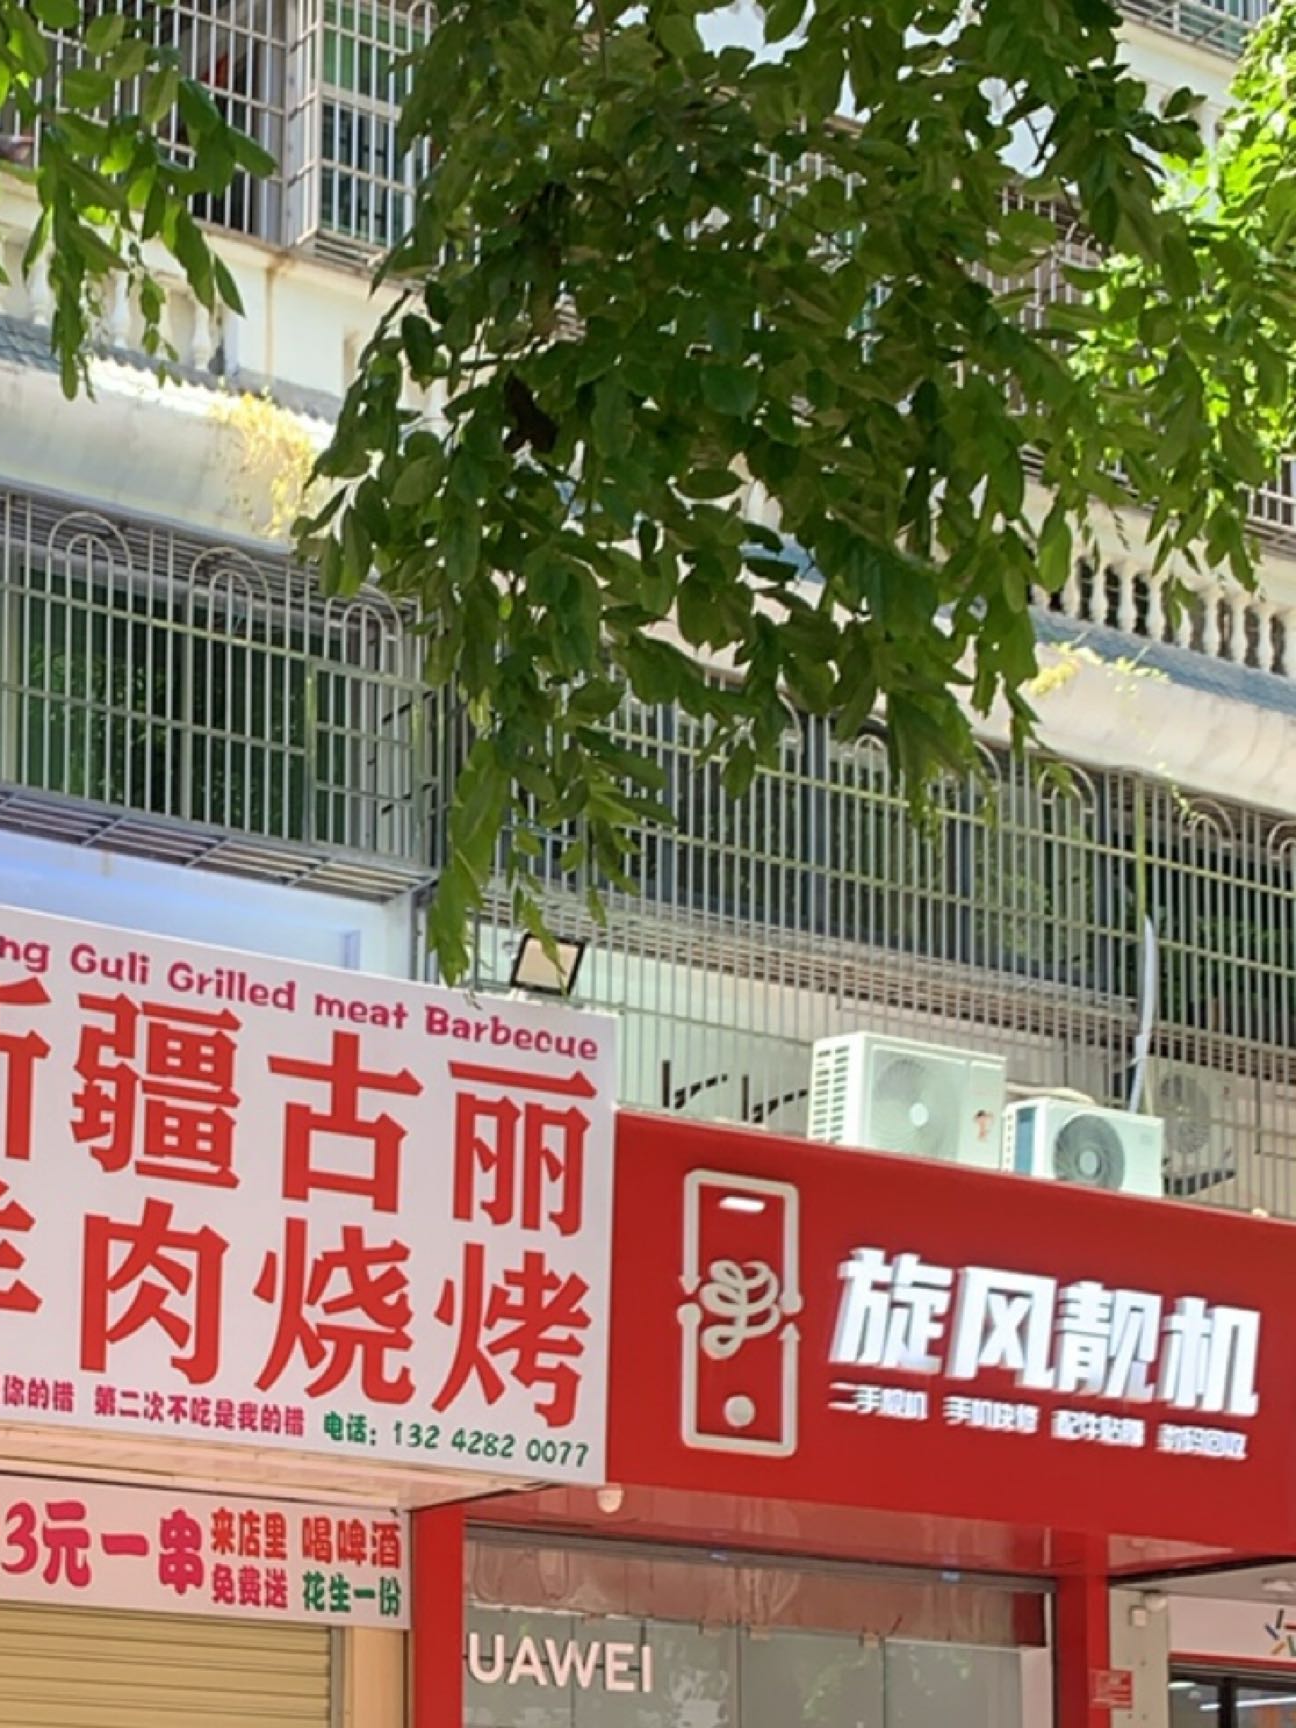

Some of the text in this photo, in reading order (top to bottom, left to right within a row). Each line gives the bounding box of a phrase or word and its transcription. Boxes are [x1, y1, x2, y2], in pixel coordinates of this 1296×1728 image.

[70, 943, 150, 985] Guli
[167, 961, 296, 1012] Grilled
[314, 993, 408, 1030] meat
[424, 1005, 599, 1060] Barbecue
[828, 1247, 1260, 1417] 旋风靓机
[93, 1384, 305, 1436] 第二次不吃是我的错
[394, 1420, 440, 1449] 132
[451, 1428, 515, 1458] 4282
[526, 1439, 589, 1468] 0077
[2, 1501, 203, 1595] 3元一串
[211, 1506, 401, 1569] 来店里 喝啤酒
[212, 1562, 401, 1616] 免费送 花生一份
[468, 1631, 652, 1693] UAWEI
